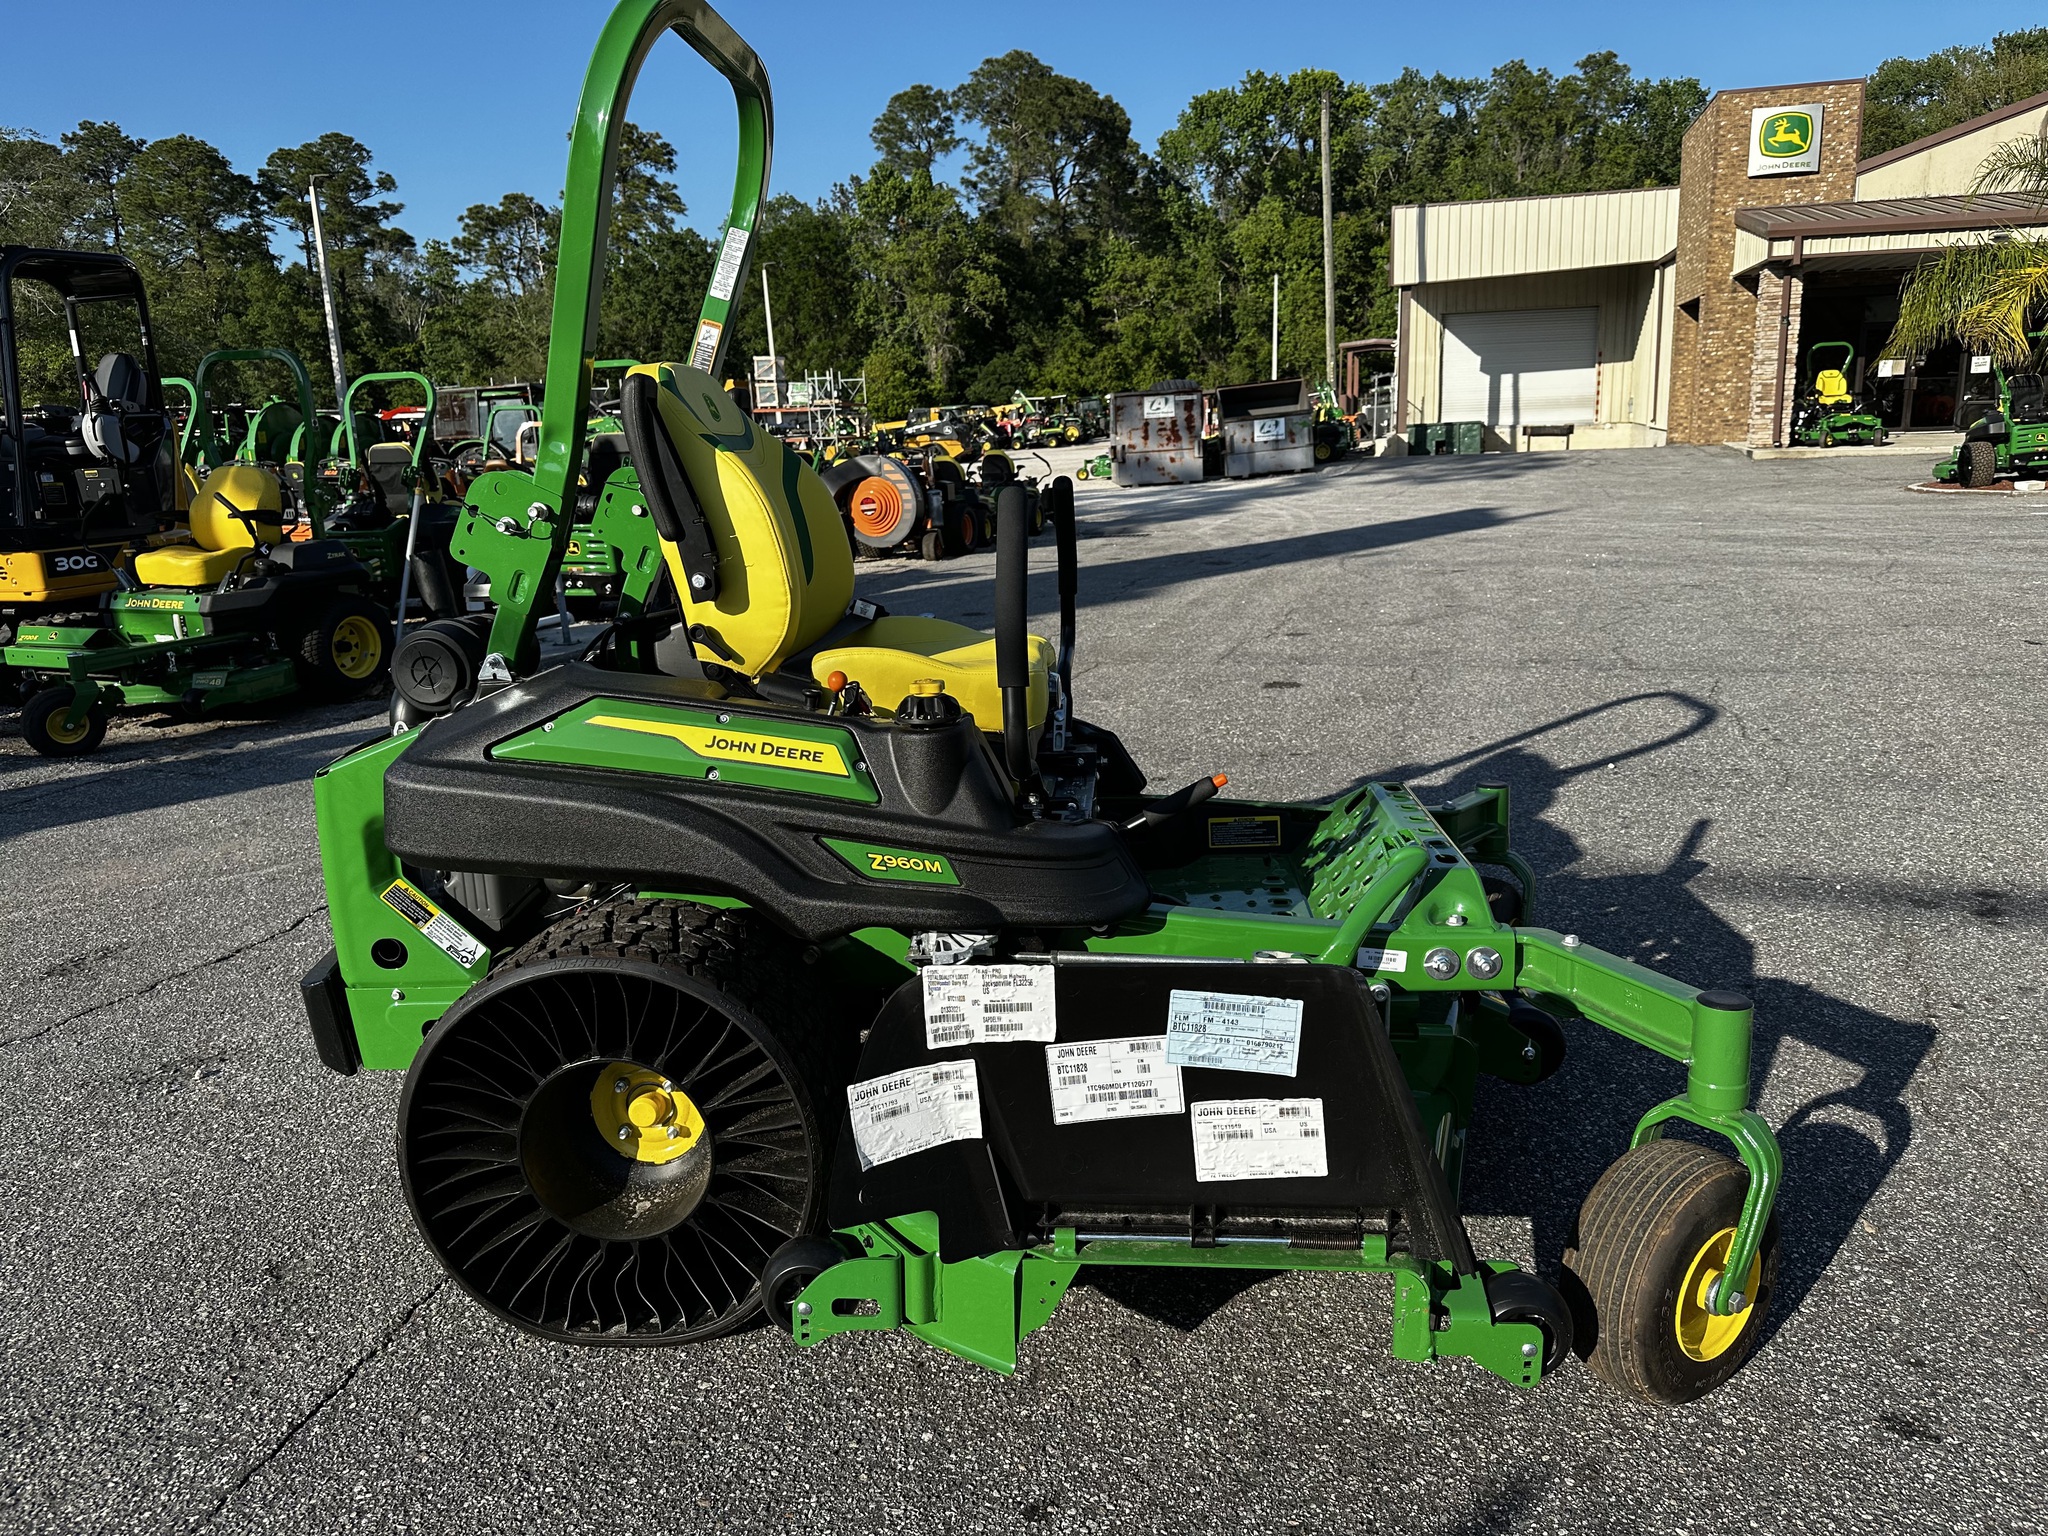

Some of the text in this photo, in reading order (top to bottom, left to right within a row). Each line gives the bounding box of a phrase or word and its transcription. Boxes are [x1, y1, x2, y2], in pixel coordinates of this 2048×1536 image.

[1756, 161, 1811, 171] JOHN DEERE
[55, 555, 98, 571] 30G
[125, 598, 184, 609] JOHN DEERE
[704, 735, 824, 763] JOHN DEERE
[867, 853, 943, 874] Z960M
[408, 890, 430, 908] CAUTION
[549, 958, 623, 970] MICHELIN
[1172, 1022, 1207, 1032] BTC11828
[1057, 1046, 1097, 1058] JOHN DEERE
[1057, 1063, 1088, 1075] BTC11828
[854, 1077, 911, 1102] JOHN DEERE
[919, 1095, 932, 1104] USA
[1197, 1106, 1257, 1117] JOHN DEERE
